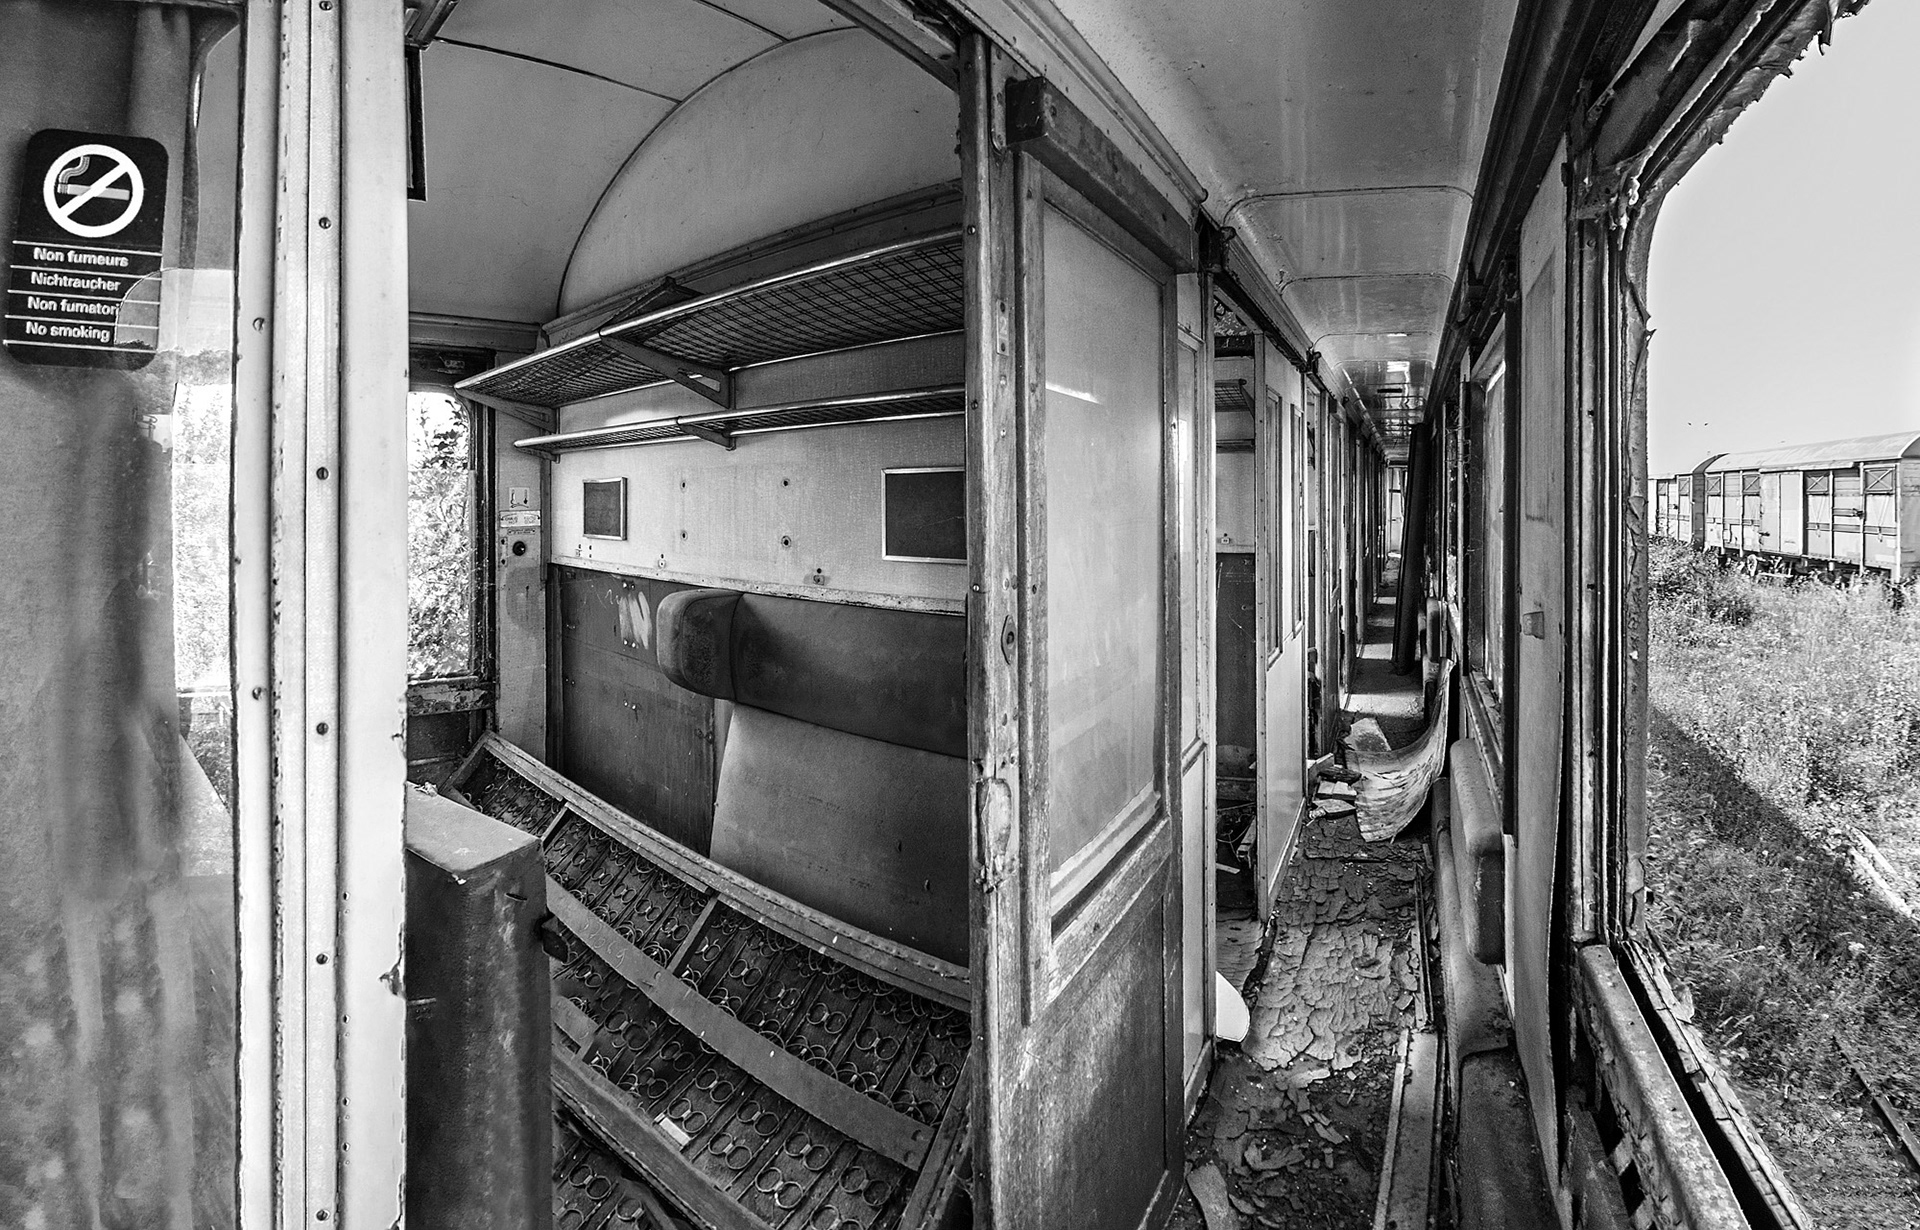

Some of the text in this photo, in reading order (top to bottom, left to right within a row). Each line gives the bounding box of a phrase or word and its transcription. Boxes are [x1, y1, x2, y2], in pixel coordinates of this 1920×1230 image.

[33, 247, 129, 267] Non fumeurs
[30, 271, 121, 291] Nichtraucher
[27, 296, 120, 315] Non fumatori
[25, 321, 110, 342] No smoking
